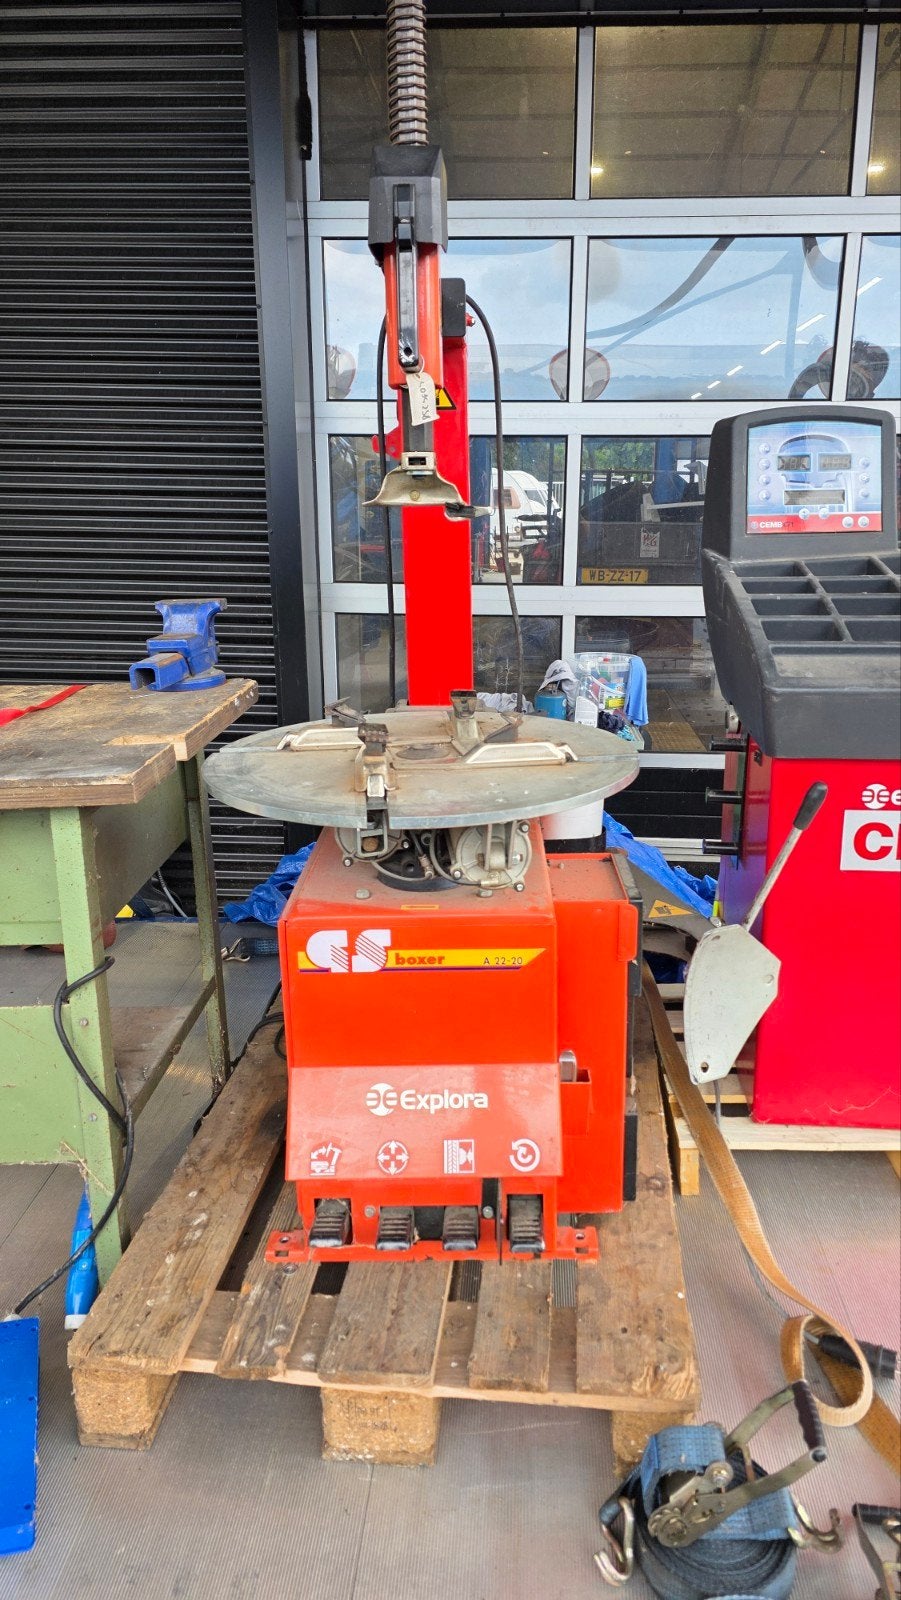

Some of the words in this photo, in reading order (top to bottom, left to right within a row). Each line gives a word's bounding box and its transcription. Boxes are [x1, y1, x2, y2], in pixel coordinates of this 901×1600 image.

[759, 521, 783, 529] CEMB
[589, 569, 641, 582] WB-ZZ-17
[853, 822, 900, 860] C
[395, 953, 445, 965] boxer
[483, 957, 490, 965] A
[495, 956, 523, 965] 22-20
[400, 1089, 489, 1114] Explora
